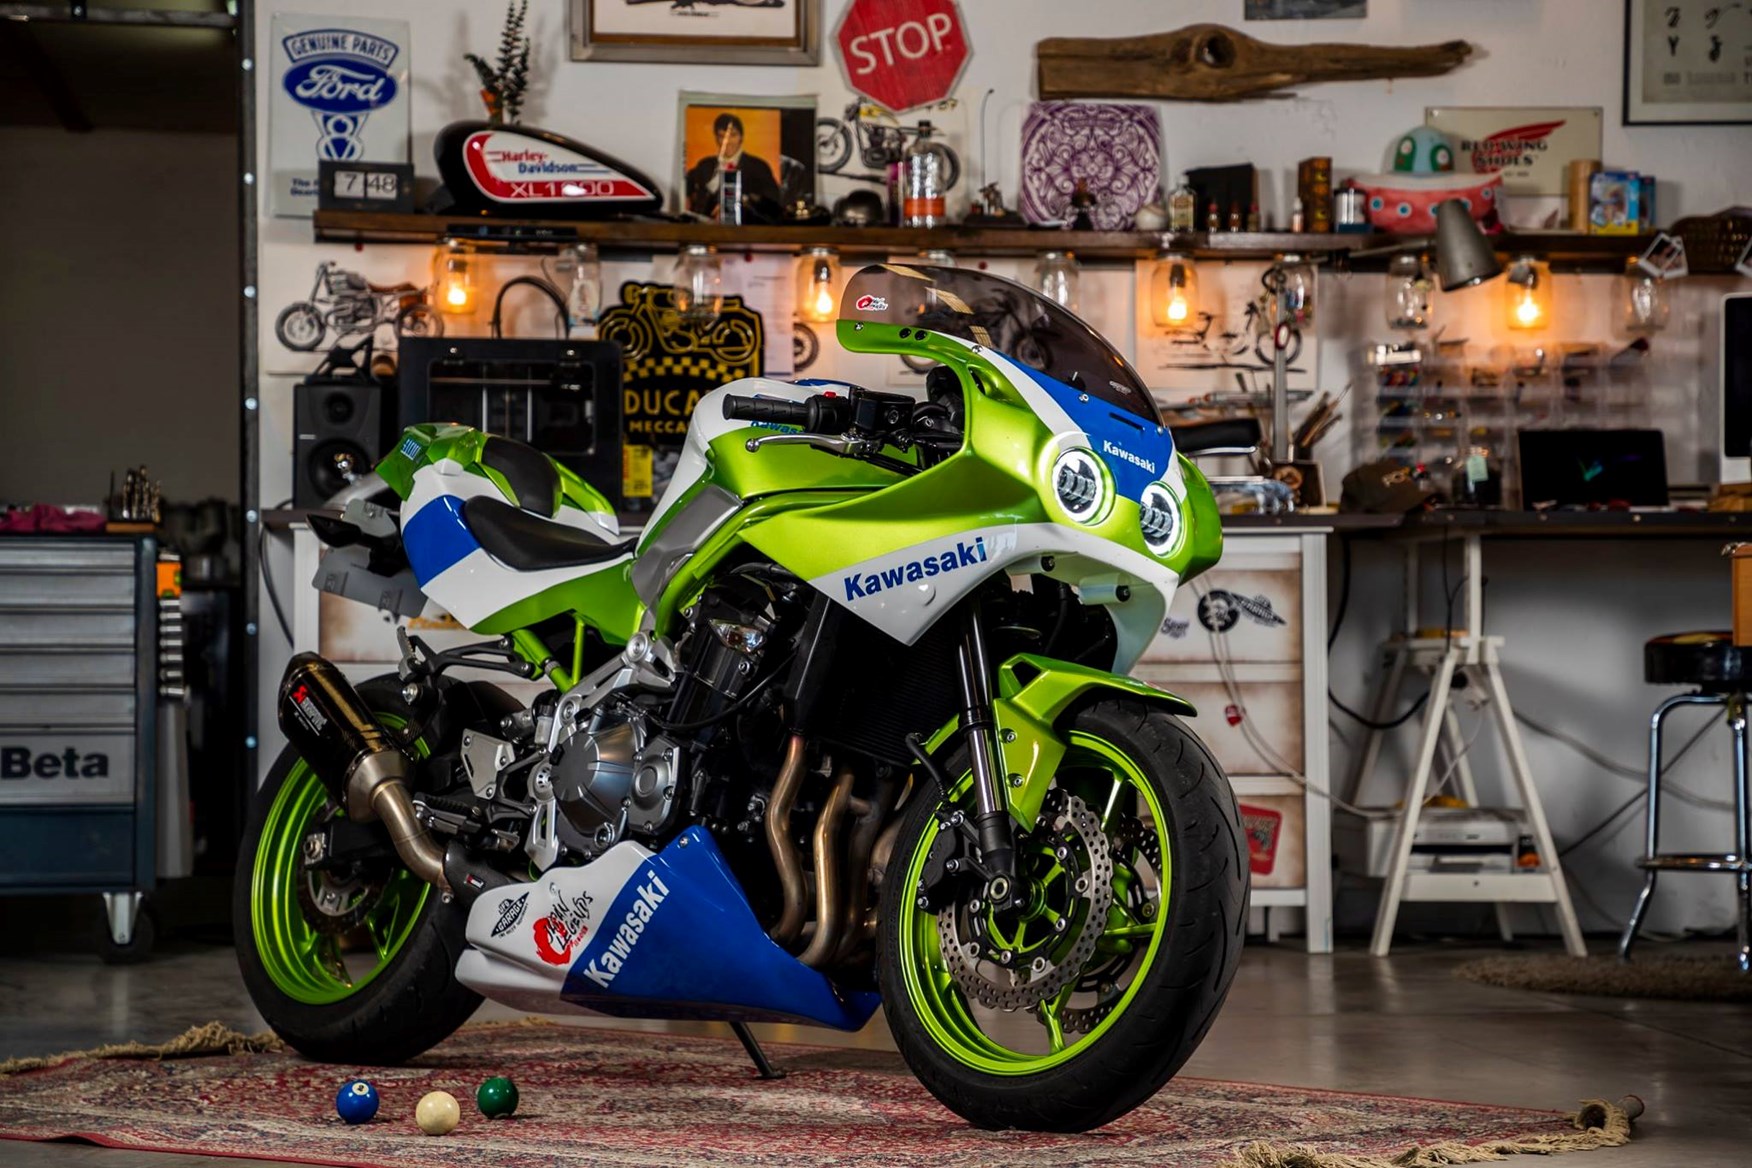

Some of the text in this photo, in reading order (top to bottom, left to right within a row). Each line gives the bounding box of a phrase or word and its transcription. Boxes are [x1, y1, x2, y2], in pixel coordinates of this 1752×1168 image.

[291, 34, 393, 62] GENUINE PARTS
[850, 12, 952, 75] STOP
[295, 64, 386, 101] Ford
[345, 174, 396, 193] 7 48
[518, 161, 577, 174] Davidson
[623, 389, 701, 417] DUCA
[629, 421, 688, 434] MECCA
[1103, 439, 1156, 475] Kawasaki
[844, 536, 987, 602] Kawasaki
[1, 746, 109, 779] Beta
[498, 901, 523, 931] GARAGE
[556, 891, 594, 951] LEGENDS
[583, 869, 670, 989] Kawasaki
